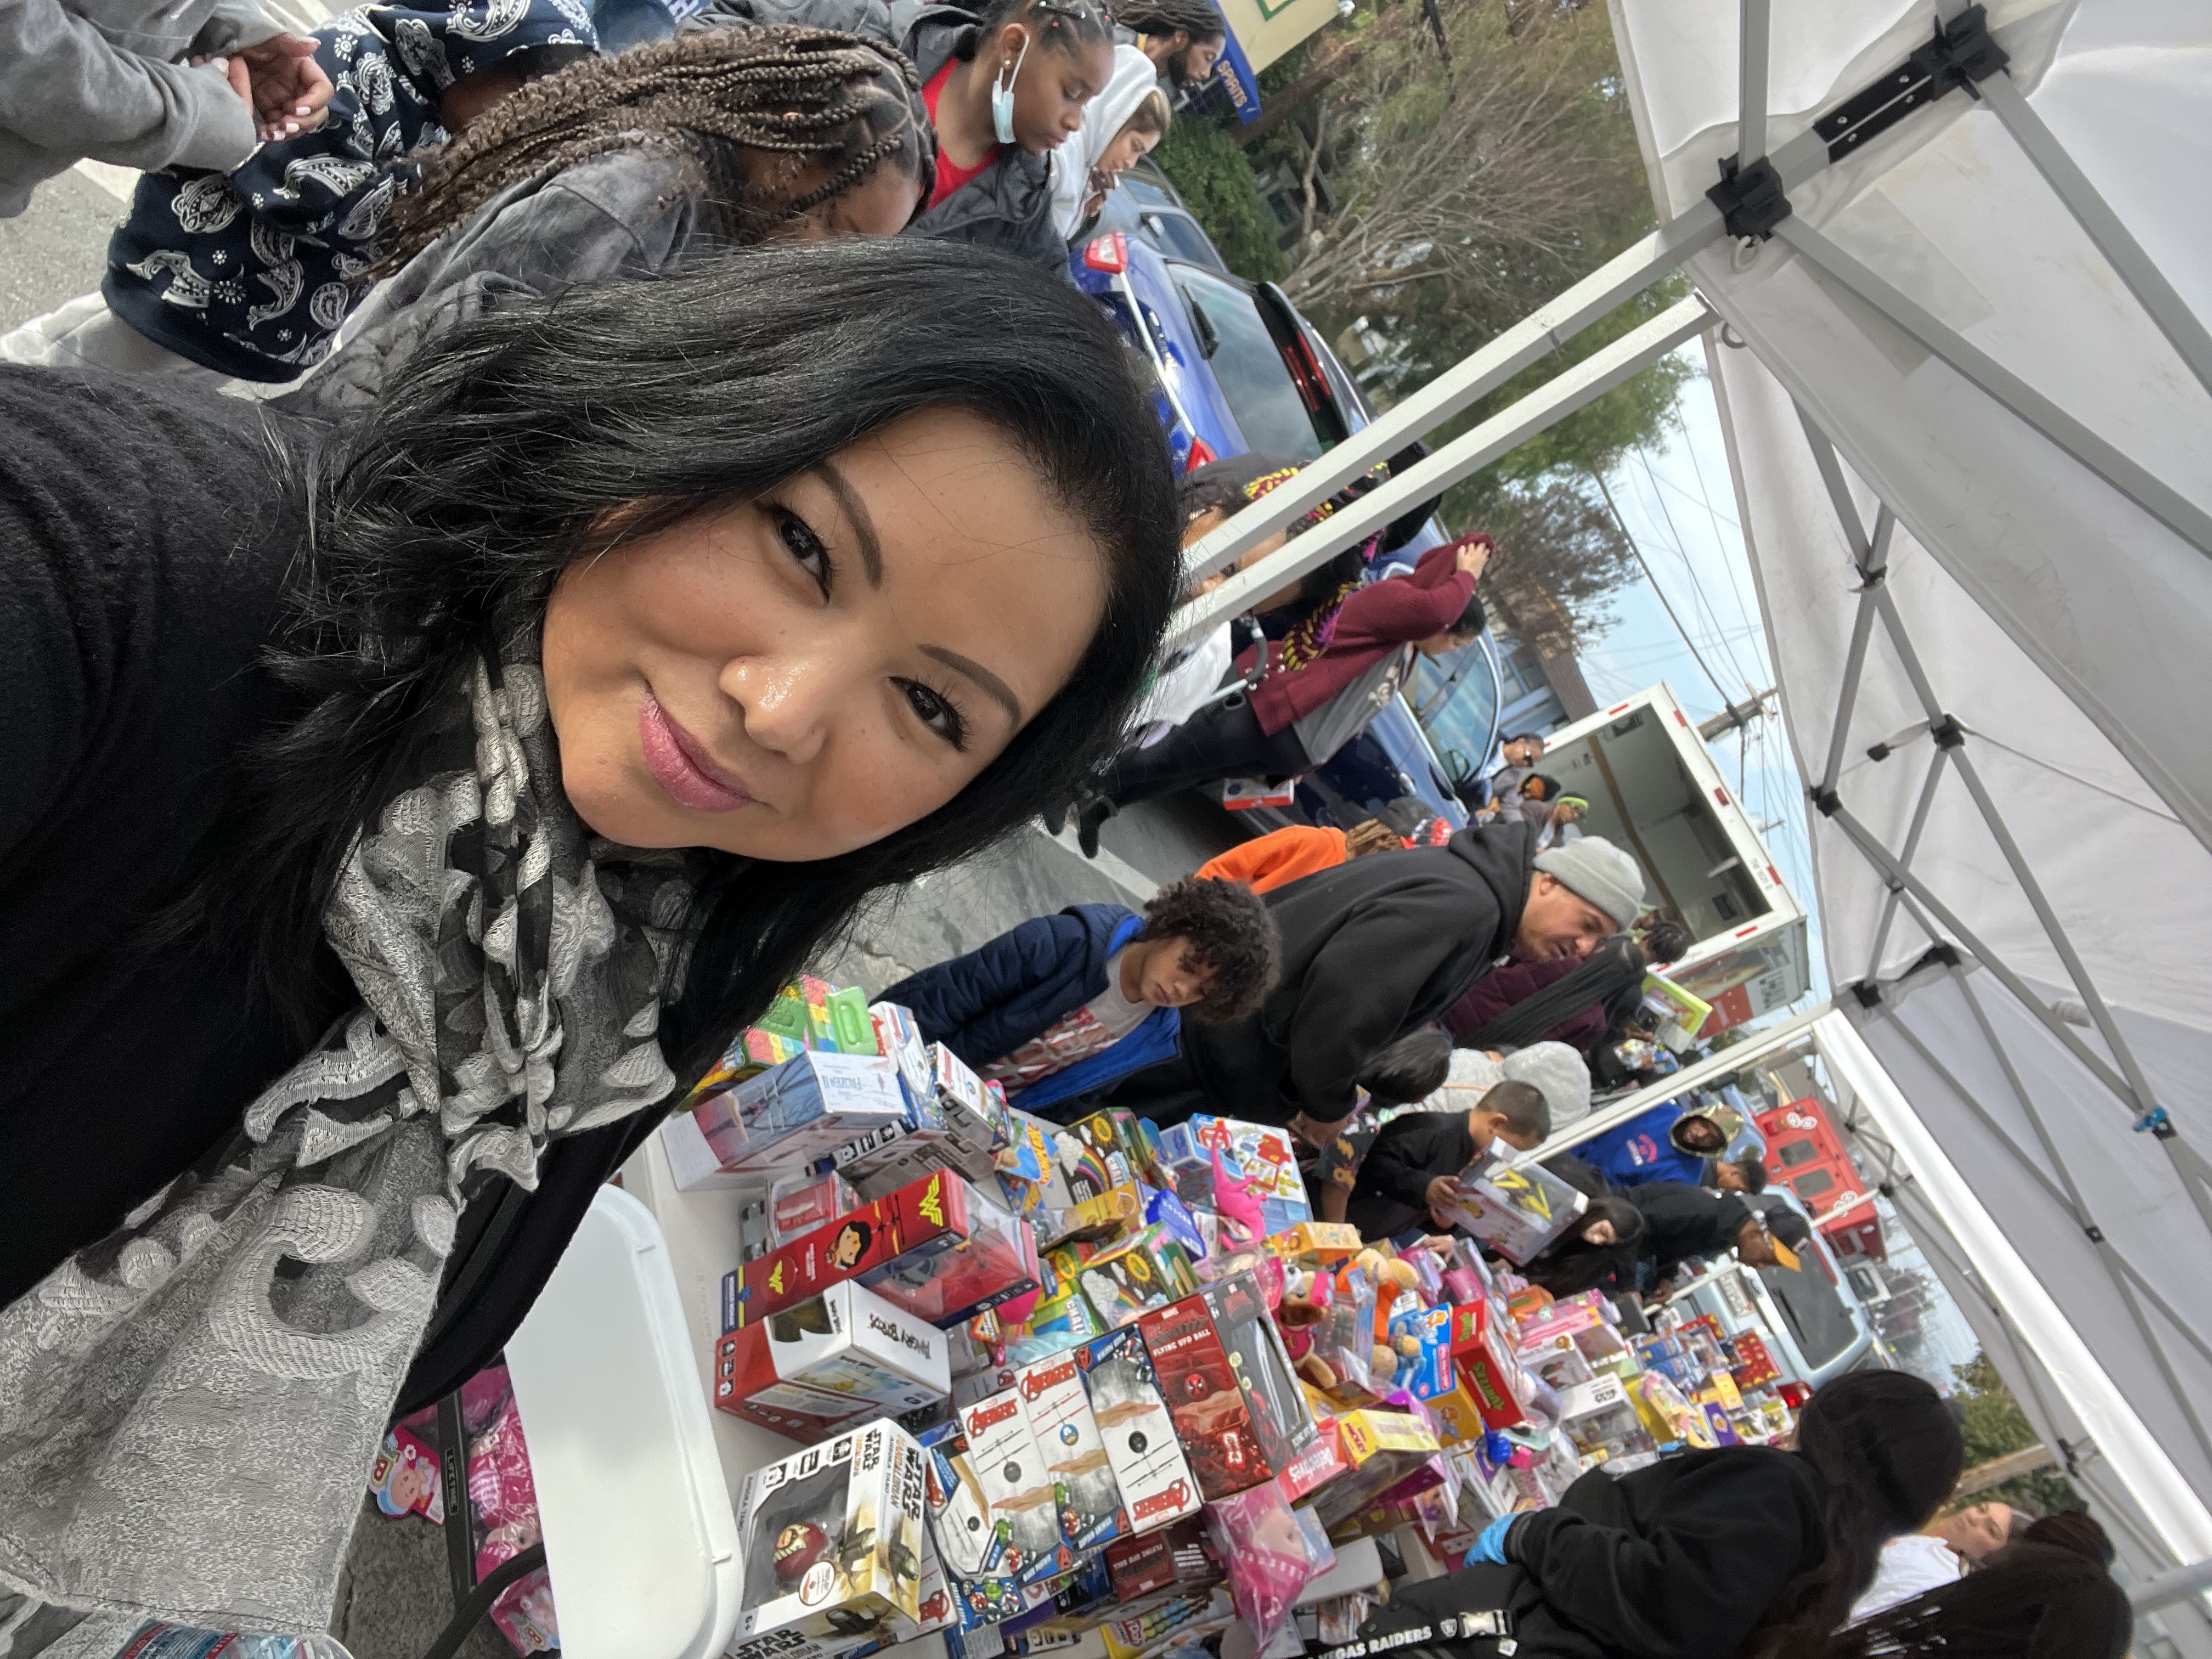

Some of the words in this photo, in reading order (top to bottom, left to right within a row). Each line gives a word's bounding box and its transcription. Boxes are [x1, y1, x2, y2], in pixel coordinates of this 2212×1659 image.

[1217, 60, 1247, 107] SPIRITS
[829, 1077, 862, 1090] FROZEN
[1153, 1341, 1177, 1357] FLYING
[1177, 1335, 1193, 1346] UFO
[1193, 1328, 1211, 1341] BALL
[862, 1433, 872, 1471] WARS
[871, 1428, 881, 1471] STAR
[902, 1454, 915, 1521] WARS
[908, 1446, 923, 1519] STAR
[745, 1615, 753, 1630] 6+
[736, 1629, 802, 1657] STAR
[1368, 1625, 1432, 1654] RAIDERS
